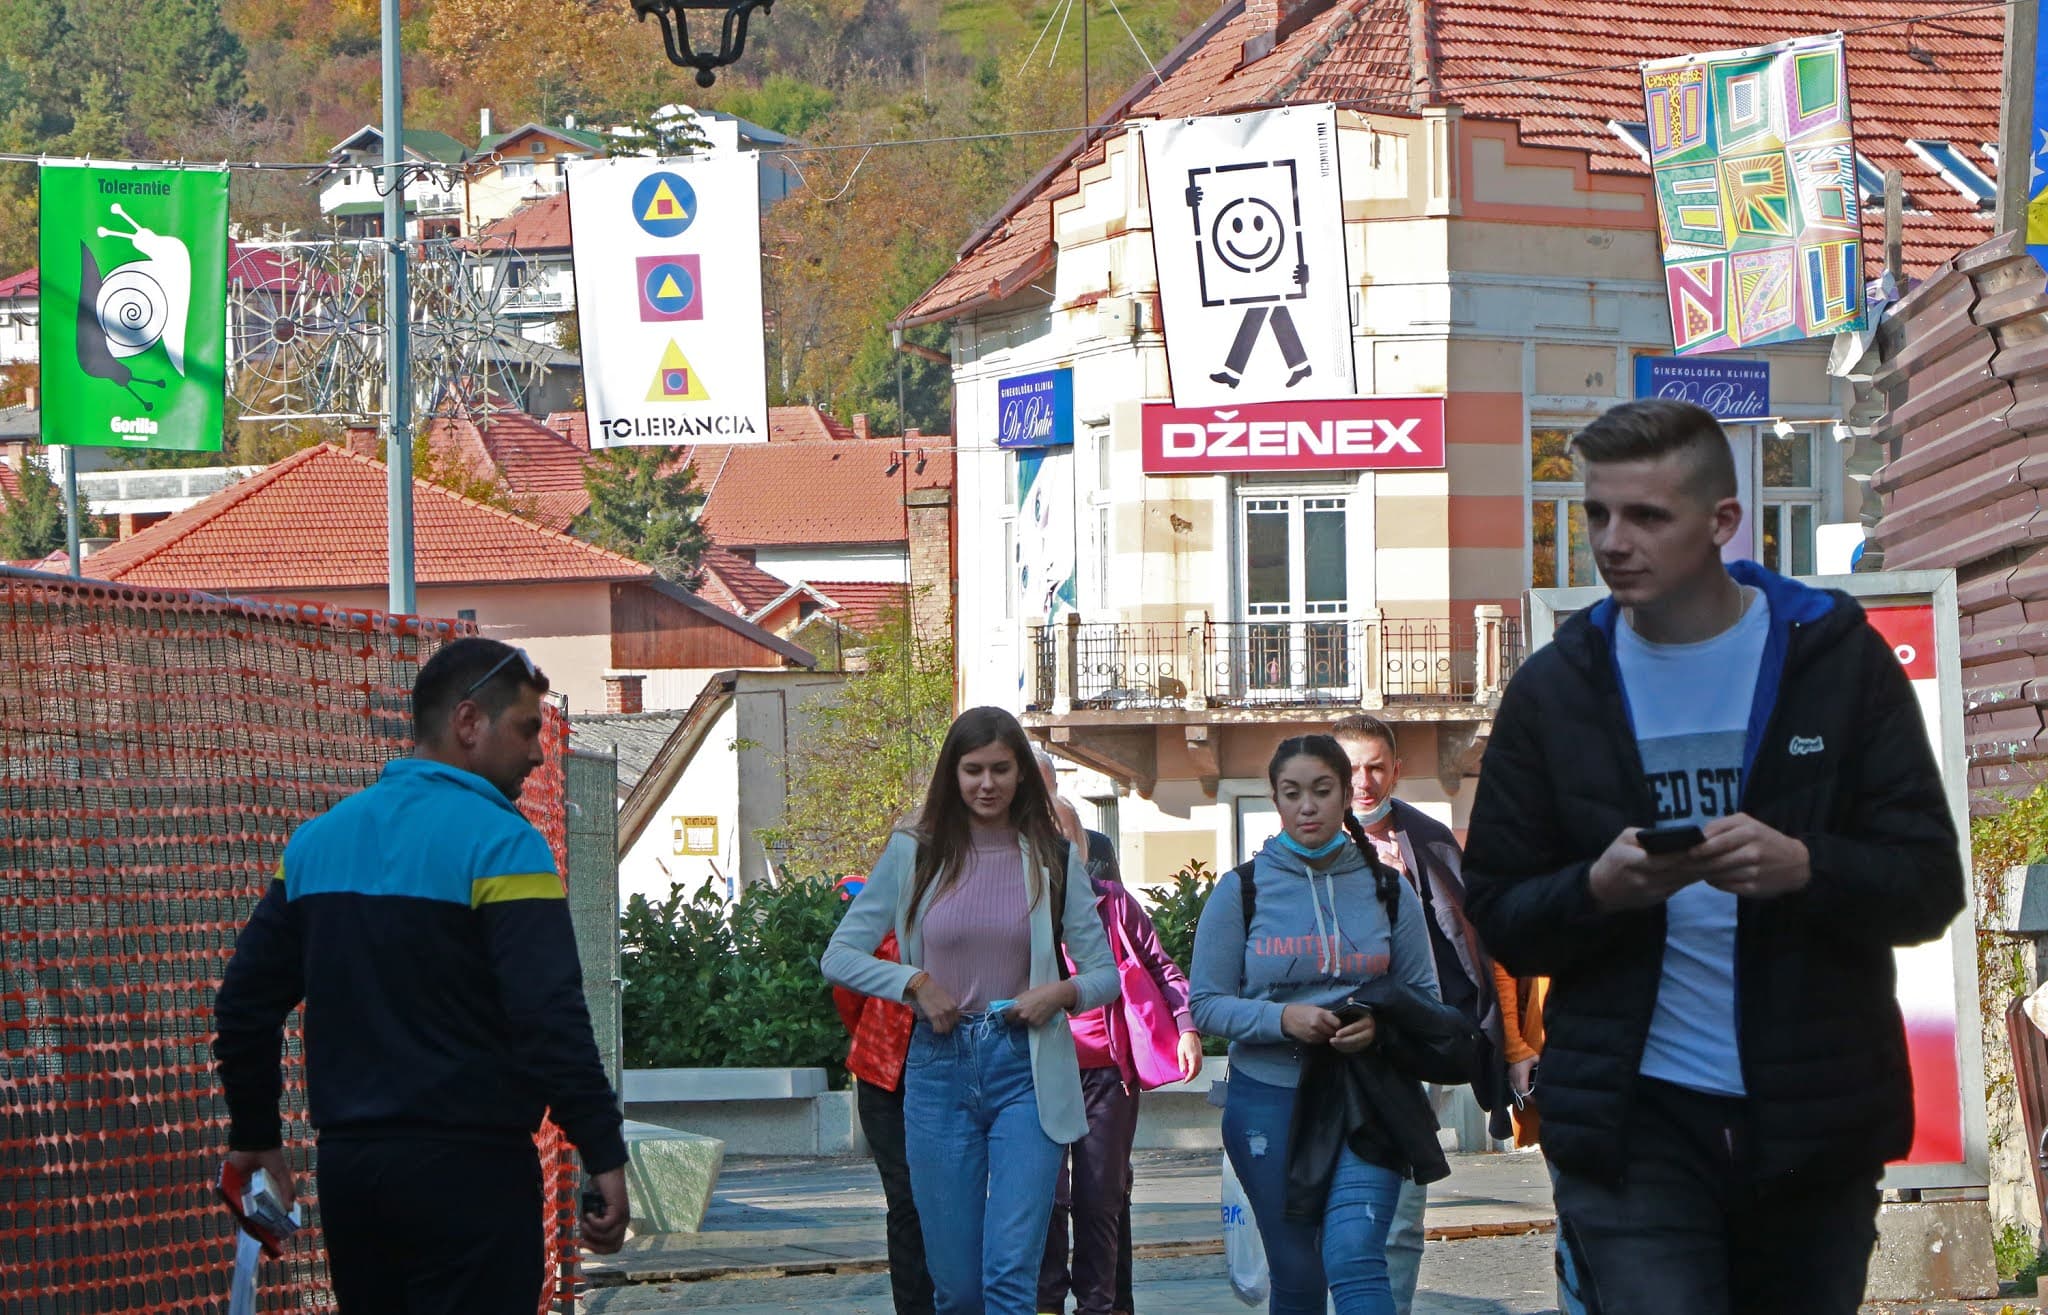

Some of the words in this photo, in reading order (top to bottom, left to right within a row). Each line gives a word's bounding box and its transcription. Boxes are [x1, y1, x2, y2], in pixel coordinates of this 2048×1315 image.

[98, 178, 171, 196] Tolerantie
[1654, 366, 1722, 377] GINEKOLOŠKA
[1727, 369, 1767, 379] KLINIKA
[110, 416, 158, 434] Gorilla
[1001, 399, 1023, 443] Dr
[1162, 409, 1423, 458] DŽENEX
[1645, 768, 1693, 821] ED
[1696, 766, 1743, 817] ST
